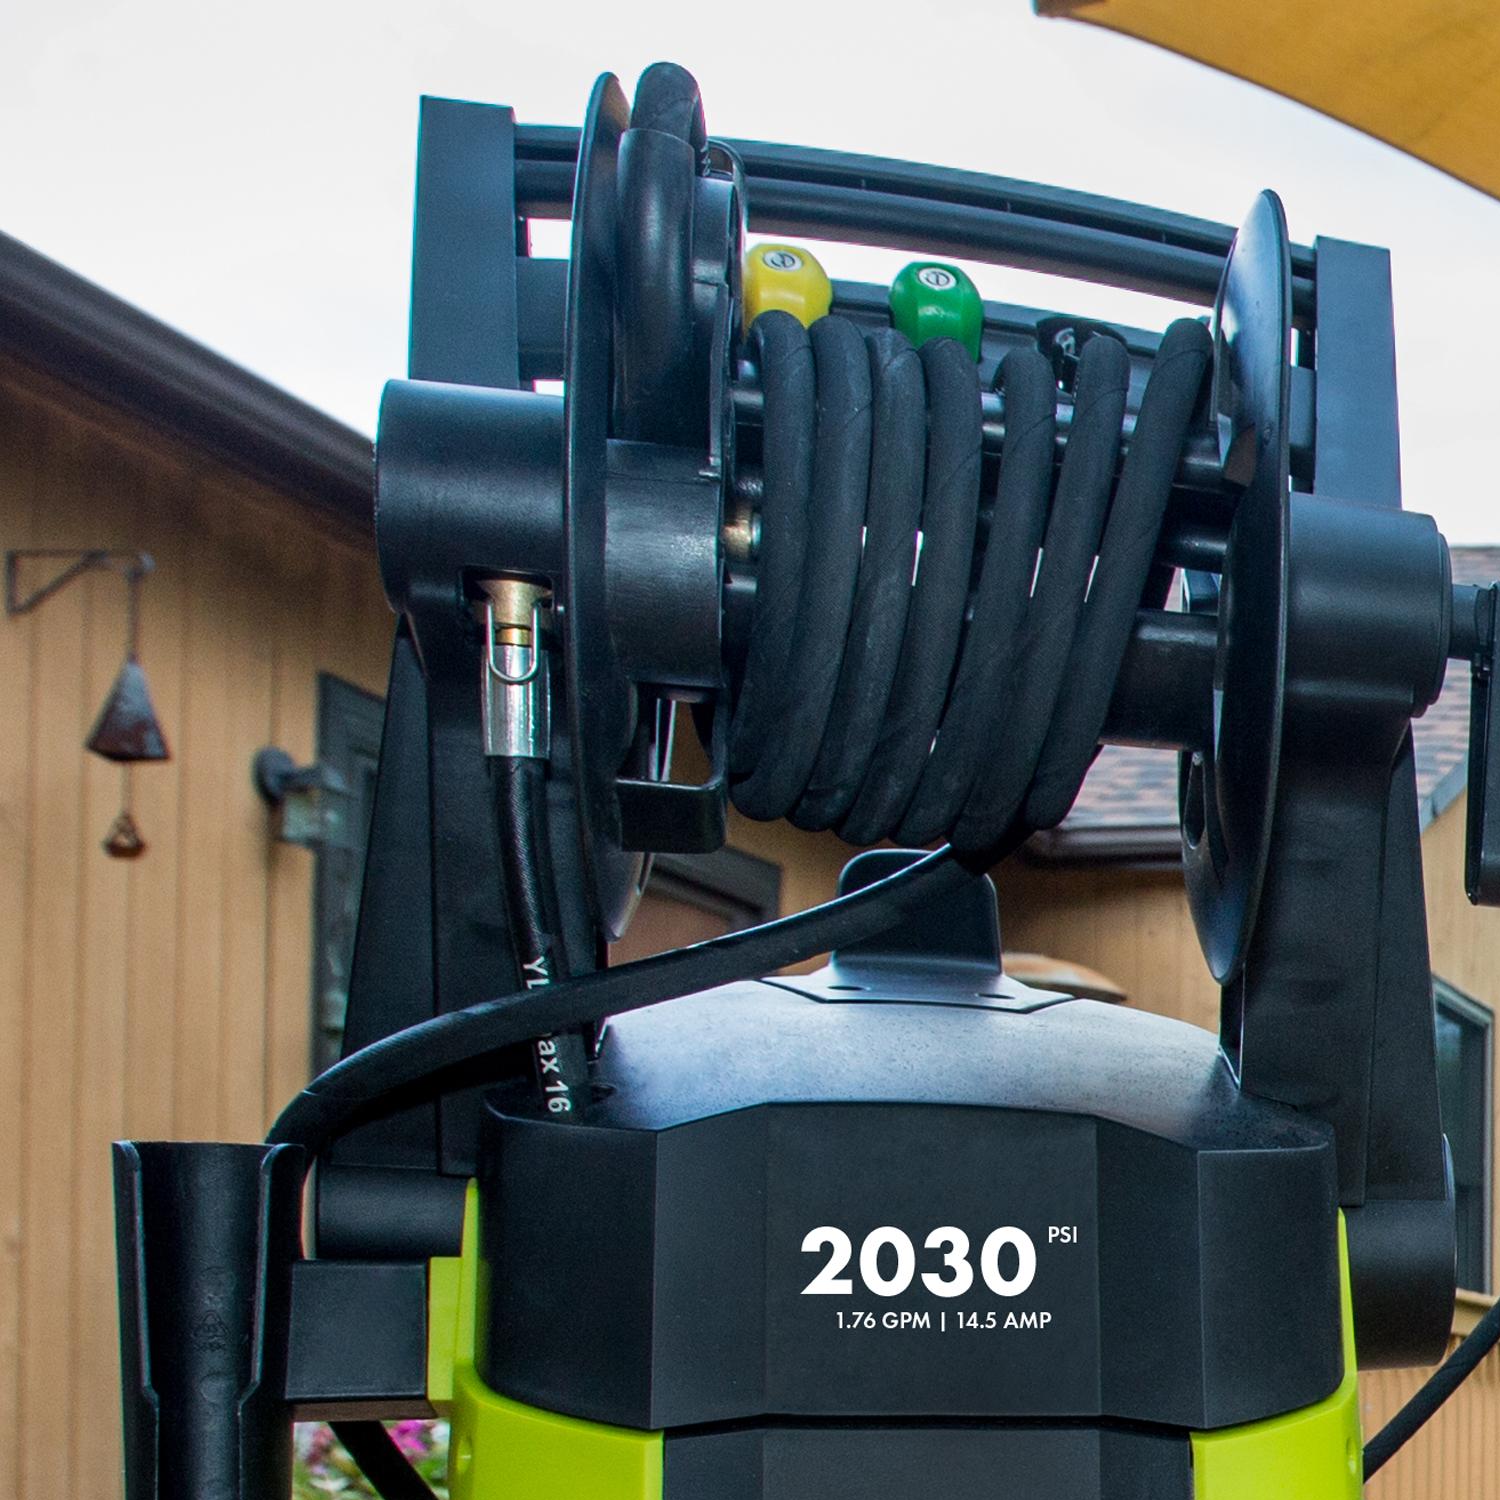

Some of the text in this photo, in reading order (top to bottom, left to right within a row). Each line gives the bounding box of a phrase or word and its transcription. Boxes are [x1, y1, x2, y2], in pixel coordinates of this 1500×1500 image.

[535, 1032, 562, 1074] ax
[544, 1079, 573, 1114] 16
[799, 1225, 1079, 1298] 2030 PSI
[836, 1311, 877, 1330] 1.76
[881, 1311, 932, 1330] GPM
[956, 1311, 998, 1330] 14.5
[1002, 1311, 1053, 1330] AMP
